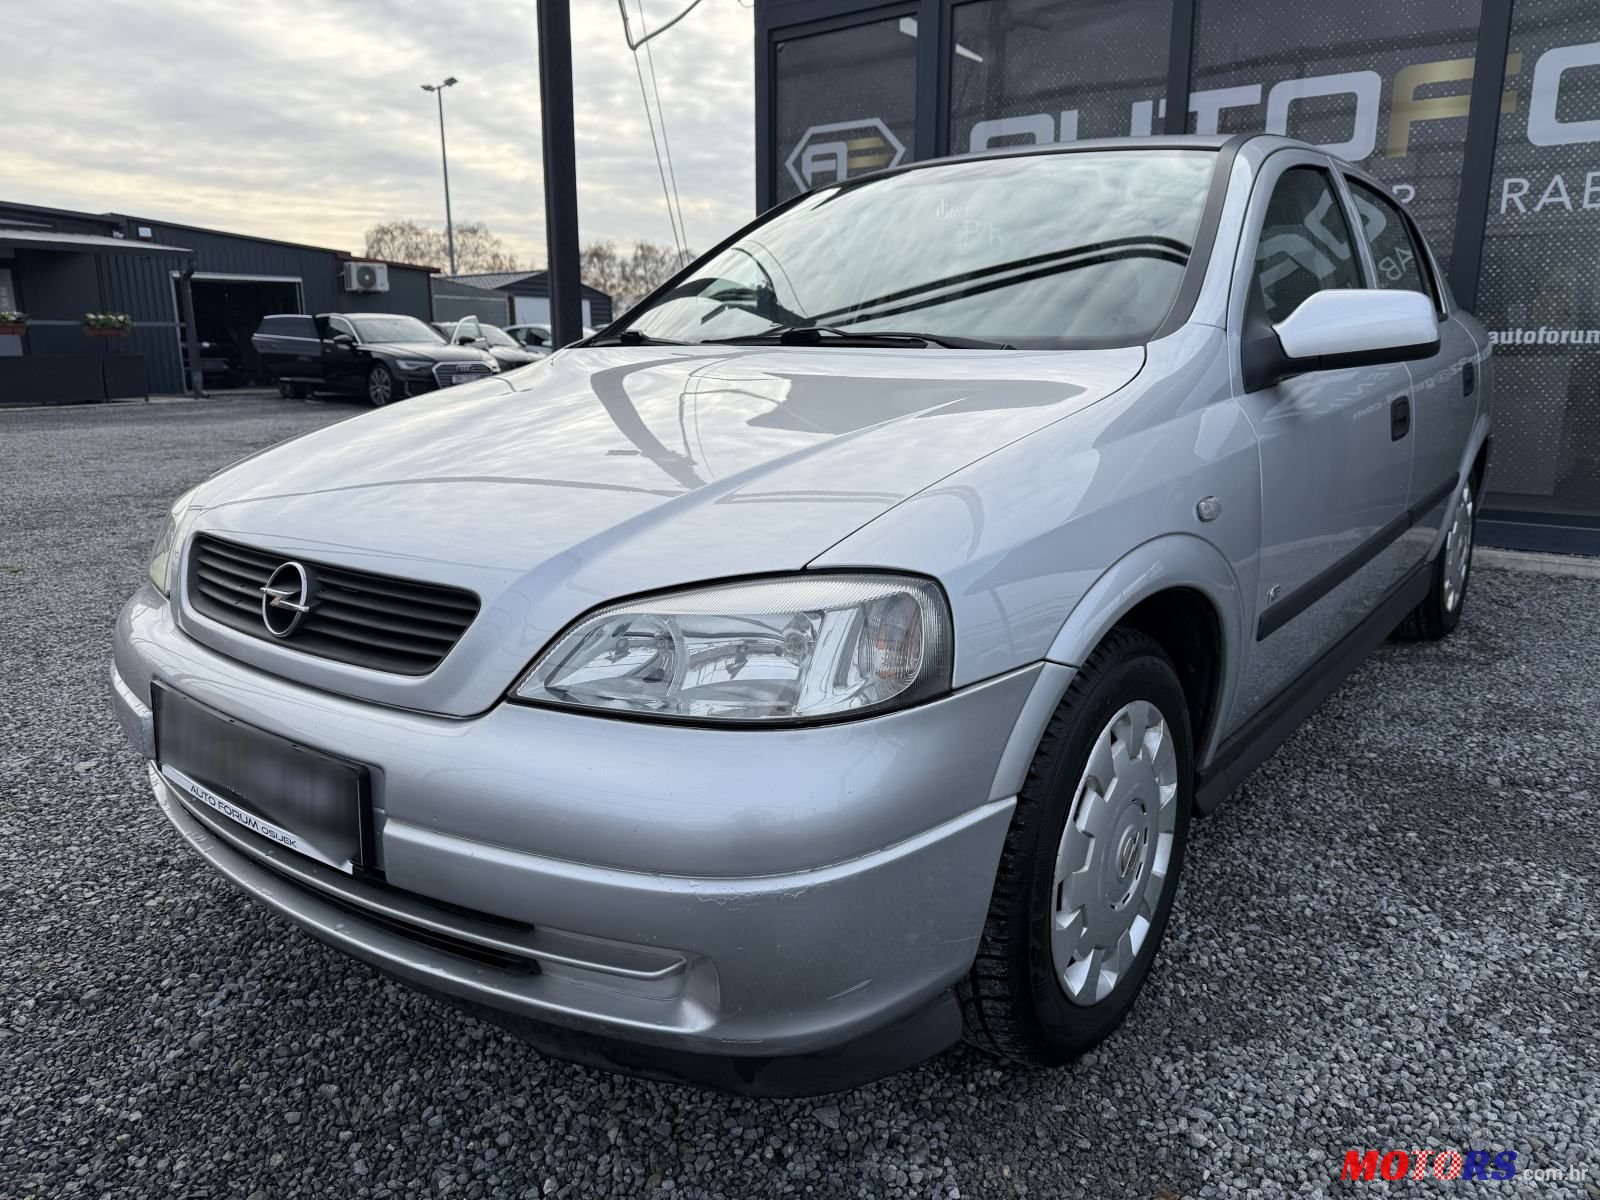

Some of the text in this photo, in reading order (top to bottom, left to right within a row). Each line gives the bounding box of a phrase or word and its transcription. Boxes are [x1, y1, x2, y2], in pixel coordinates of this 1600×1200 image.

[190, 785, 216, 806] AUTO
[218, 802, 259, 830] FORUM
[261, 826, 297, 848] OSIJEK
